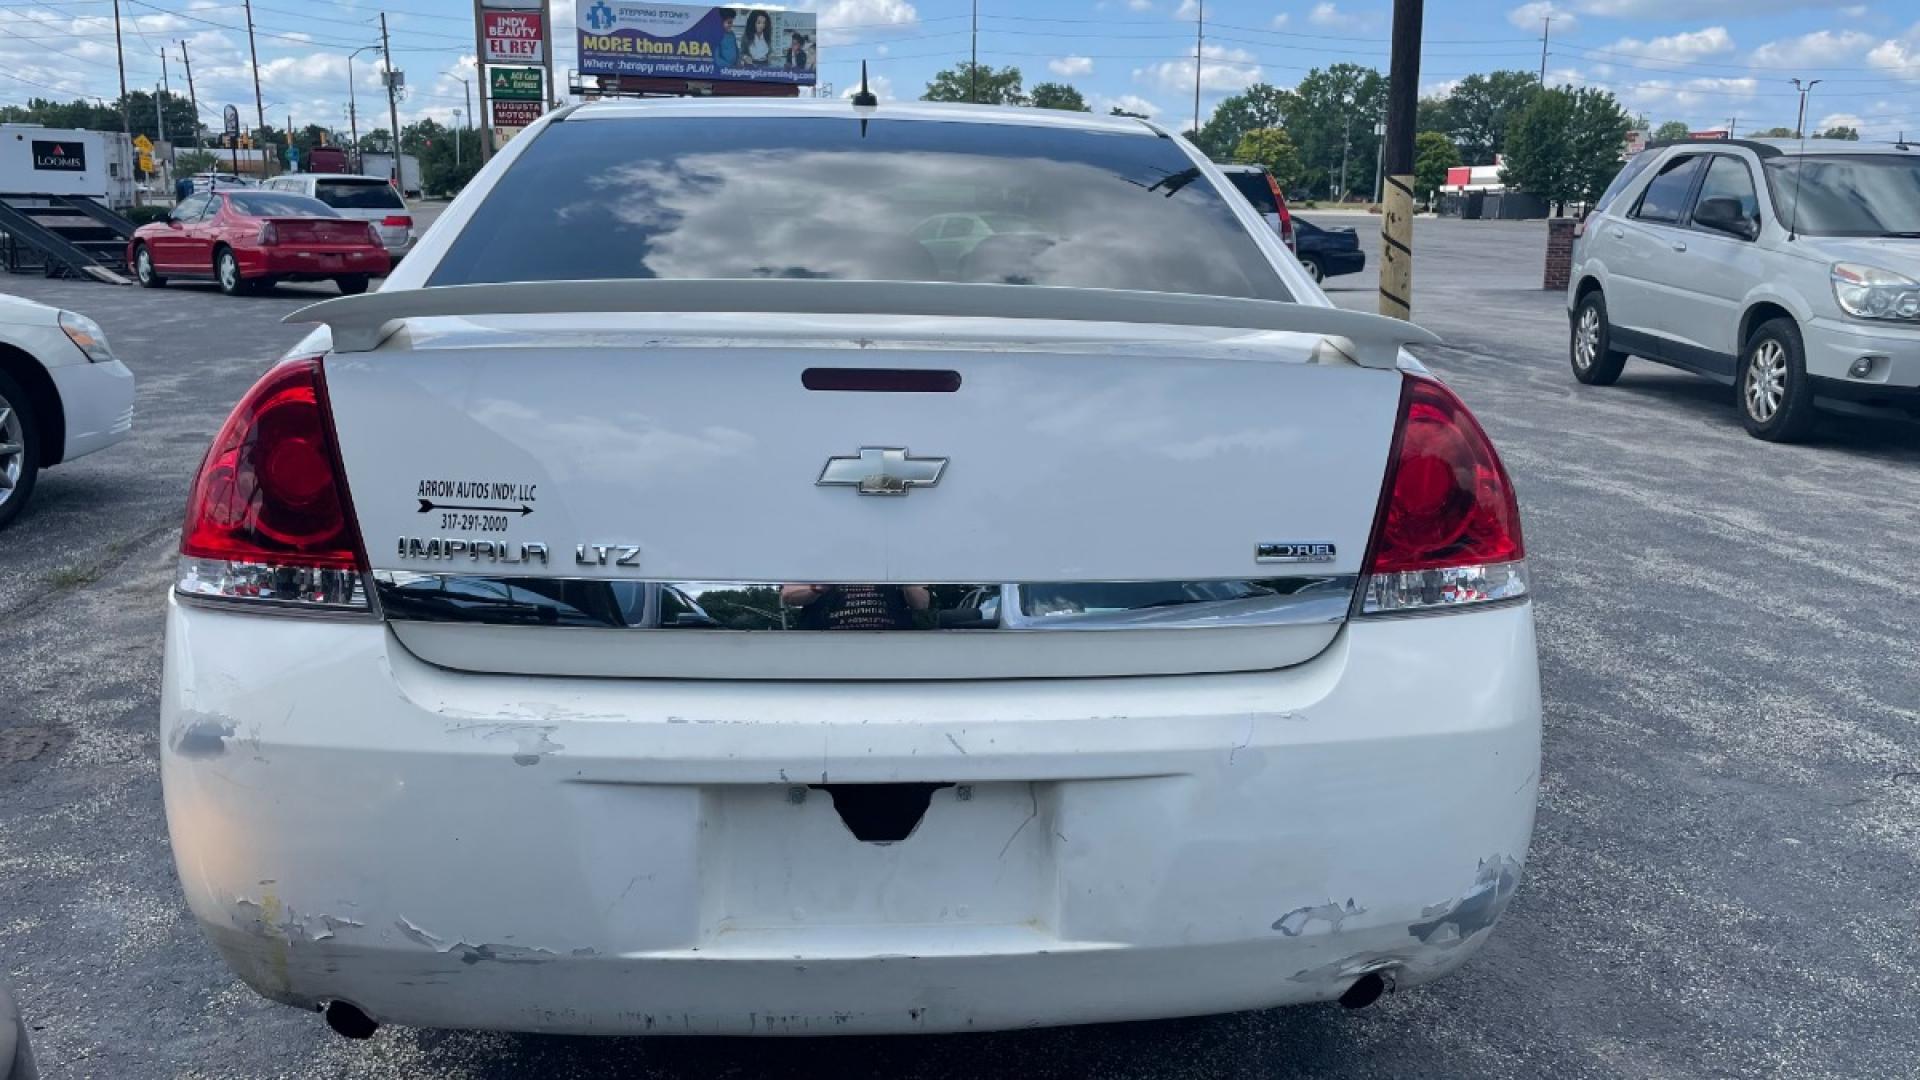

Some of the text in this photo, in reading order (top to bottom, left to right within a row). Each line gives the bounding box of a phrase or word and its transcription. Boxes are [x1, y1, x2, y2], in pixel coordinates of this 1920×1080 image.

[497, 16, 527, 27] INDY
[488, 26, 537, 38] BEAUTY
[490, 40, 537, 54] EL REY
[583, 36, 633, 52] MORE
[636, 38, 673, 54] than
[676, 41, 713, 57] ABA
[583, 58, 614, 69] Where
[655, 63, 685, 73] meets
[686, 63, 715, 74] PLAY!
[37, 155, 81, 167] LOOMIS
[417, 480, 537, 502] ARROW AUTOS INDY, LLC
[441, 513, 508, 532] 317-291-2000
[397, 536, 640, 567] IMPALA LTZ
